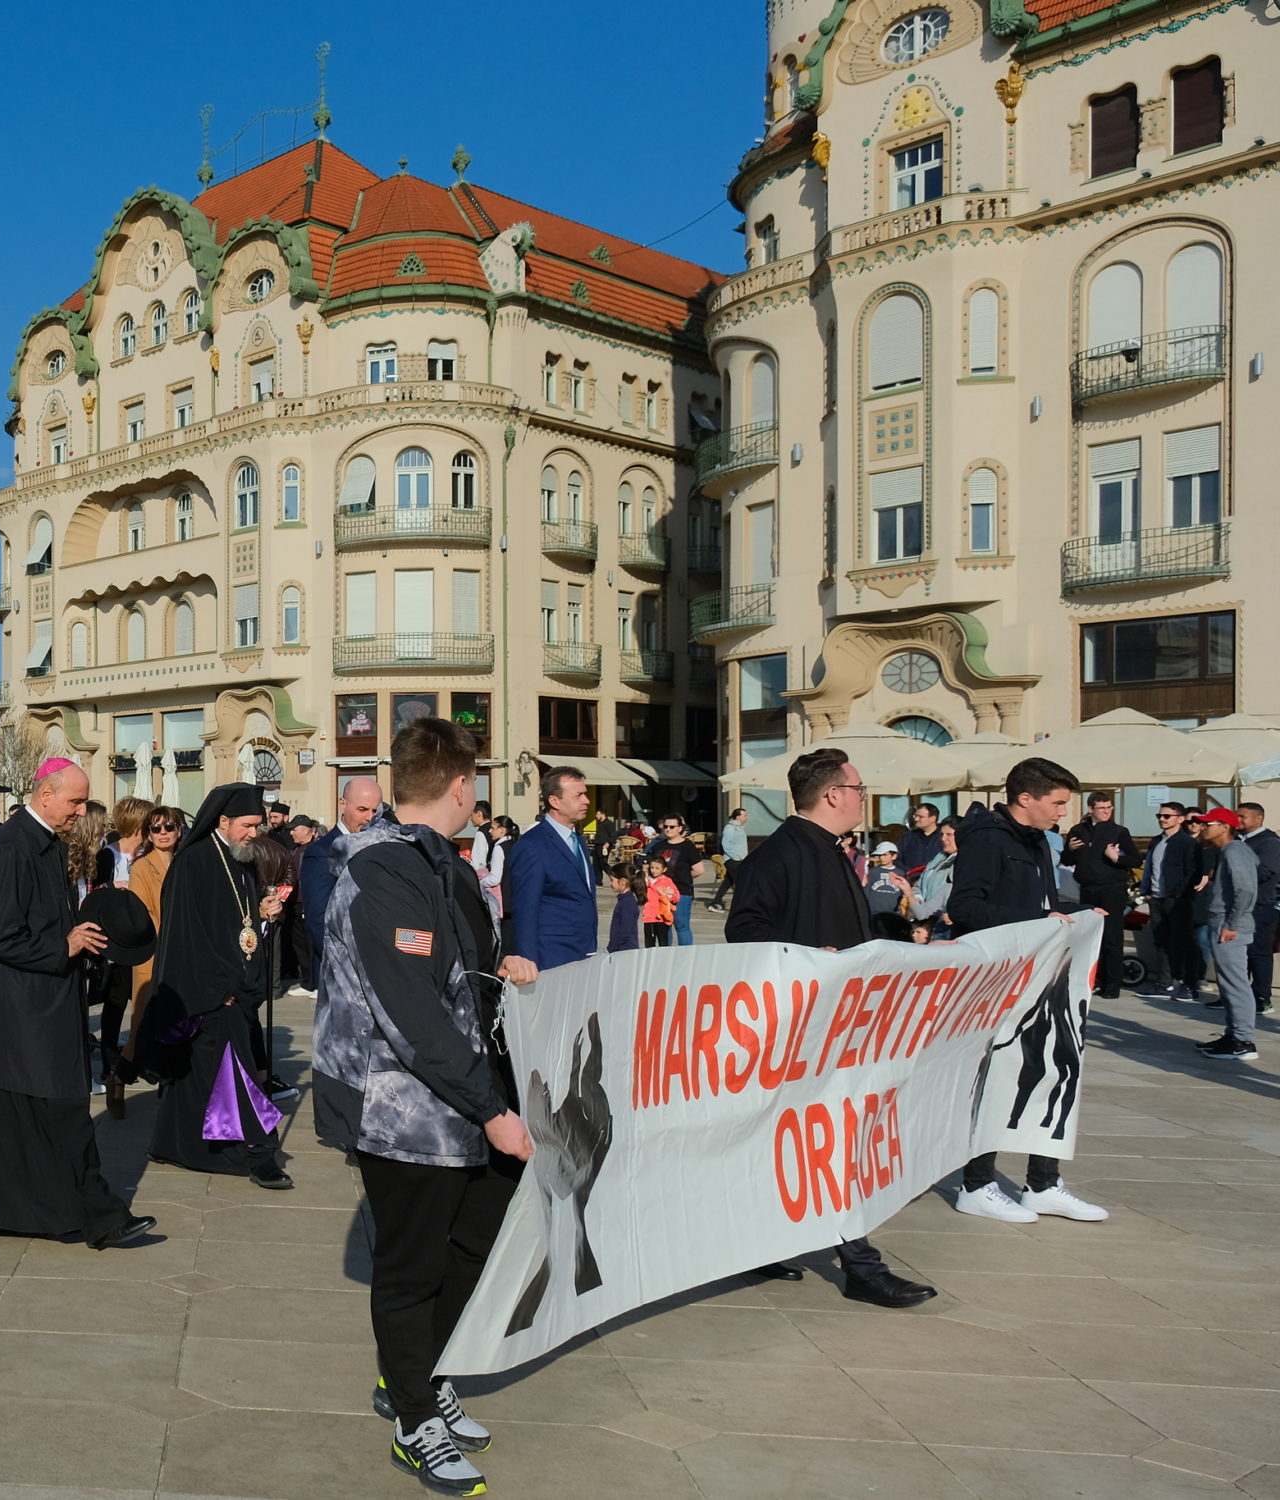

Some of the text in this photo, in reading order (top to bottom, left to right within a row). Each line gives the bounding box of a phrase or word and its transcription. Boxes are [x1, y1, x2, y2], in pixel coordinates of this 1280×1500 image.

[632, 979, 819, 1111] MARSUL
[816, 964, 983, 1077] PENTRU
[775, 1088, 903, 1223] ORADEA
